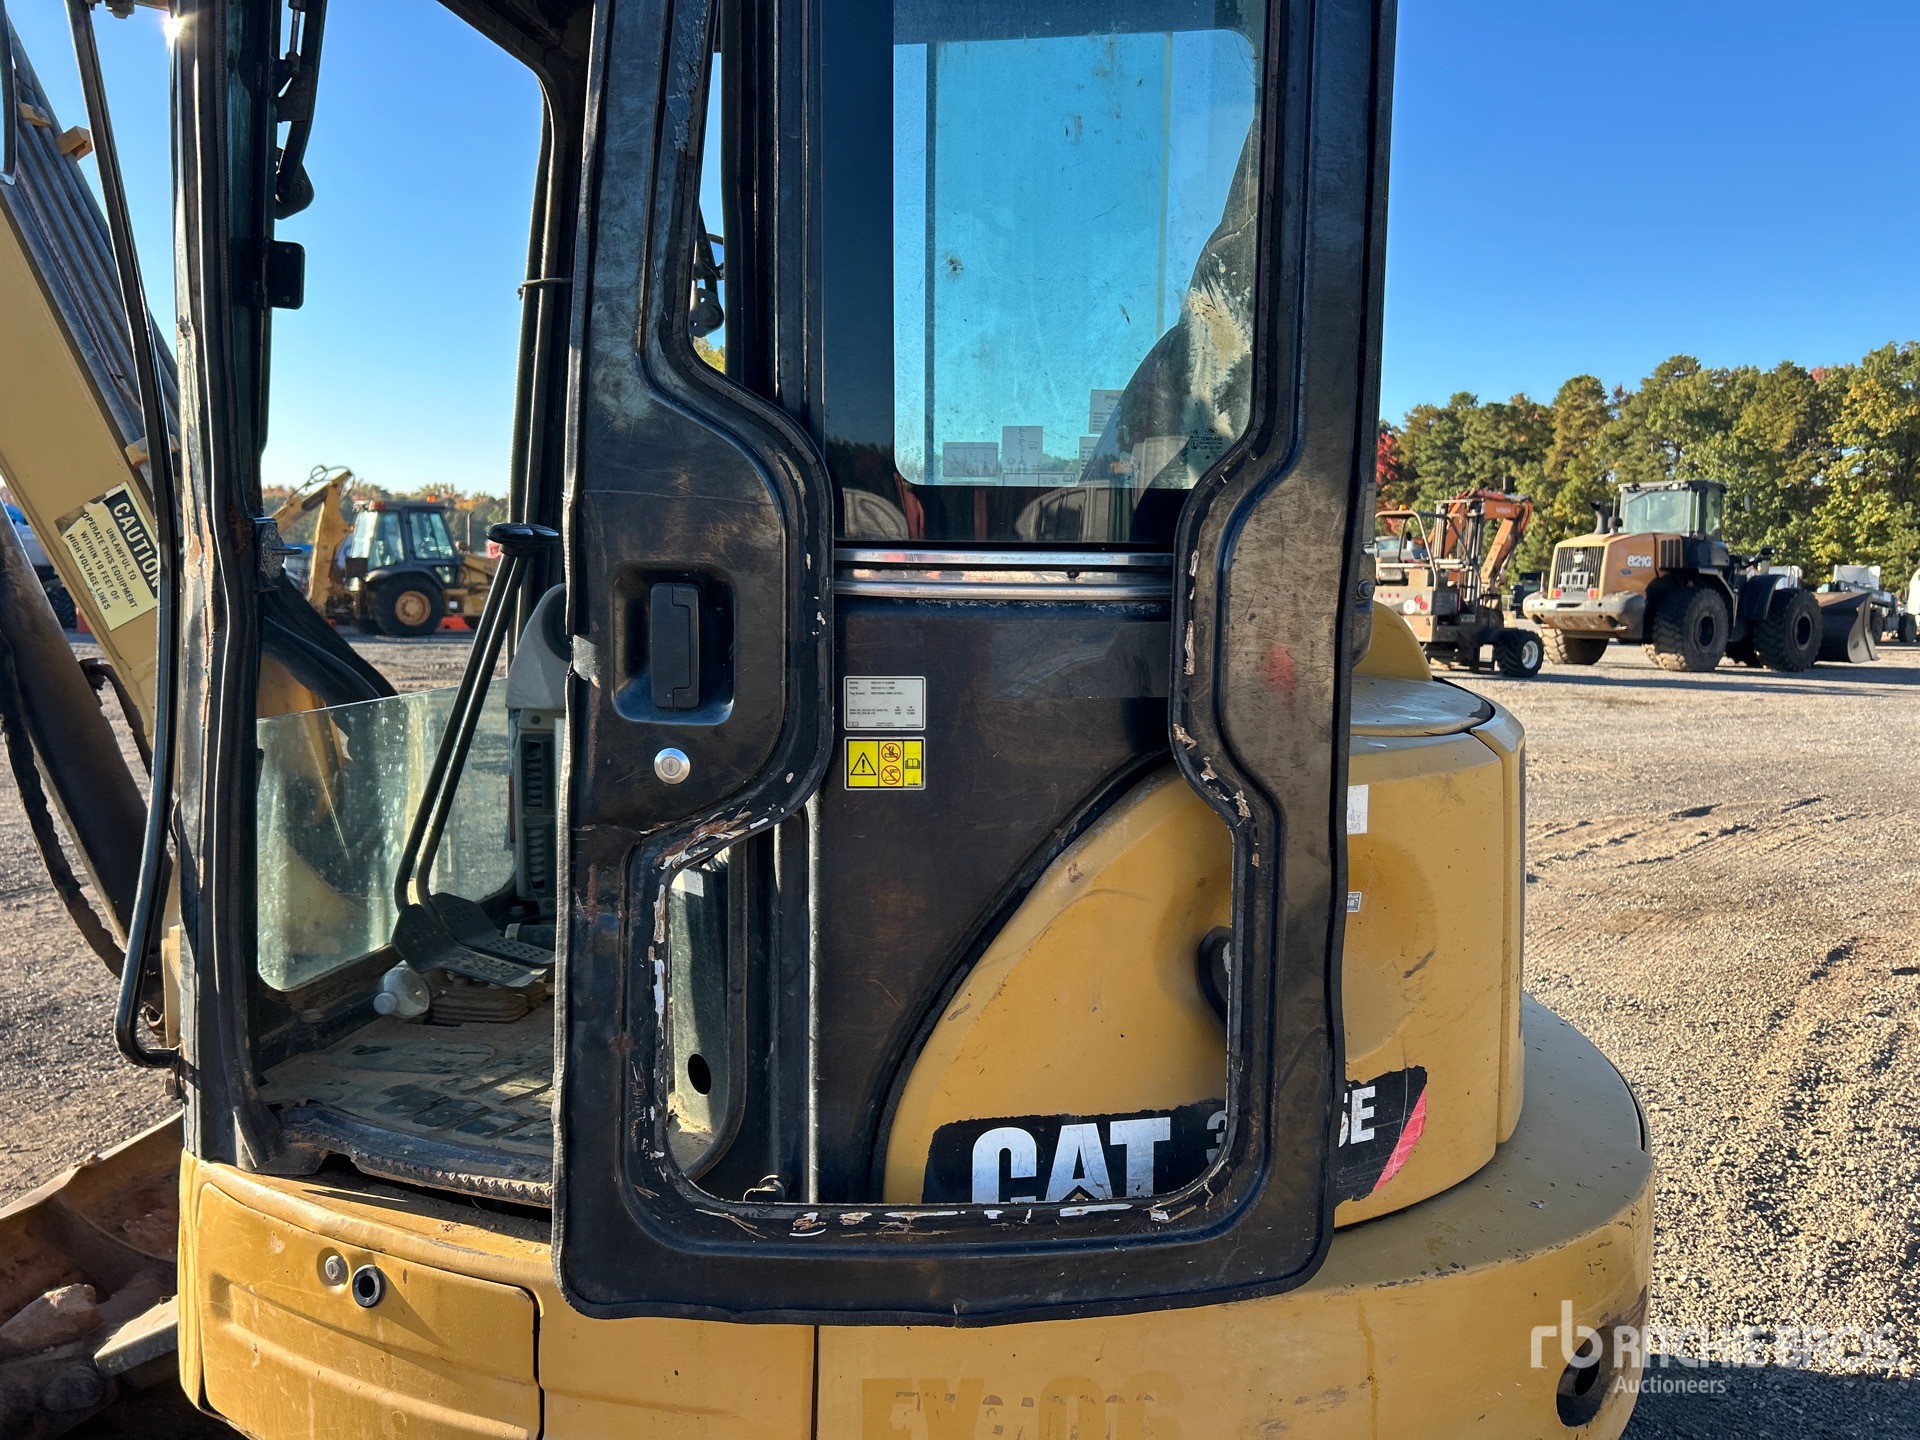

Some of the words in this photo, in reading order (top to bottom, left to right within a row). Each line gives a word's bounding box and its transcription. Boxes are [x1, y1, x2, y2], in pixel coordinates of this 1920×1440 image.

[66, 533, 82, 554] HIGH
[79, 553, 100, 587] VOLTAGE
[95, 587, 111, 610] LINES
[81, 530, 99, 560] WITHIN
[95, 560, 104, 570] 10
[100, 570, 115, 589] FEET
[110, 590, 120, 600] OF
[82, 512, 105, 545] OPERATE
[102, 546, 115, 565] THIS
[111, 564, 138, 608] EQUIPMENT
[106, 528, 130, 570] UNLAWFUL
[128, 569, 137, 581] TO
[1626, 555, 1652, 567] 821G
[971, 1116, 1171, 1203] CAT
